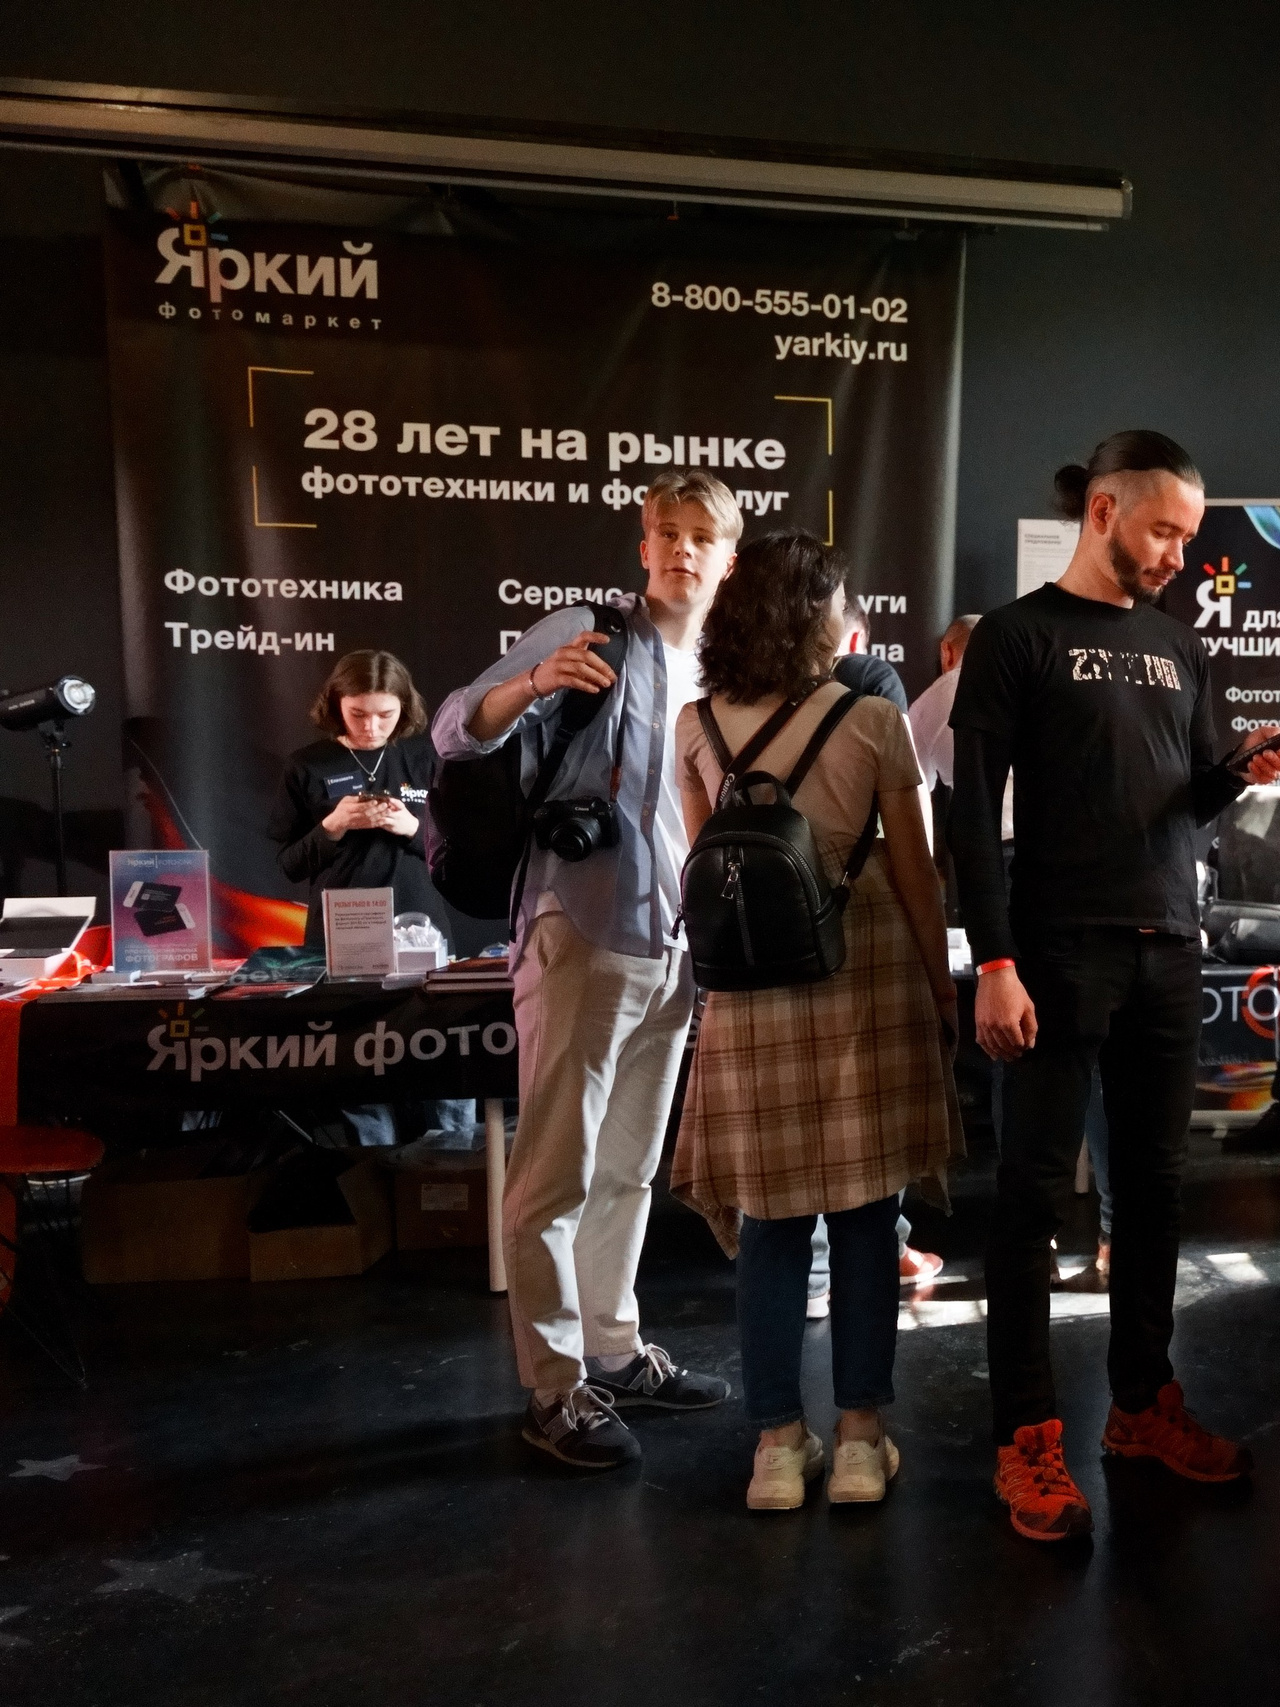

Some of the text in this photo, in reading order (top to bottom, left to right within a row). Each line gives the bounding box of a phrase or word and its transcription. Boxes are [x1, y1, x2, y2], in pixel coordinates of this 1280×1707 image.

[155, 228, 378, 302] Яркий
[158, 302, 382, 330] фотомаркет
[651, 282, 908, 323] 8-800-555-01-02
[774, 332, 908, 364] yarkiy.ru
[303, 408, 786, 471] 28 лет на рынке
[301, 466, 555, 502] фототехники
[568, 483, 589, 503] и
[164, 568, 403, 601] Фототехника
[164, 621, 334, 655] Трейд-ин
[146, 1020, 517, 1082] Яркий фото
